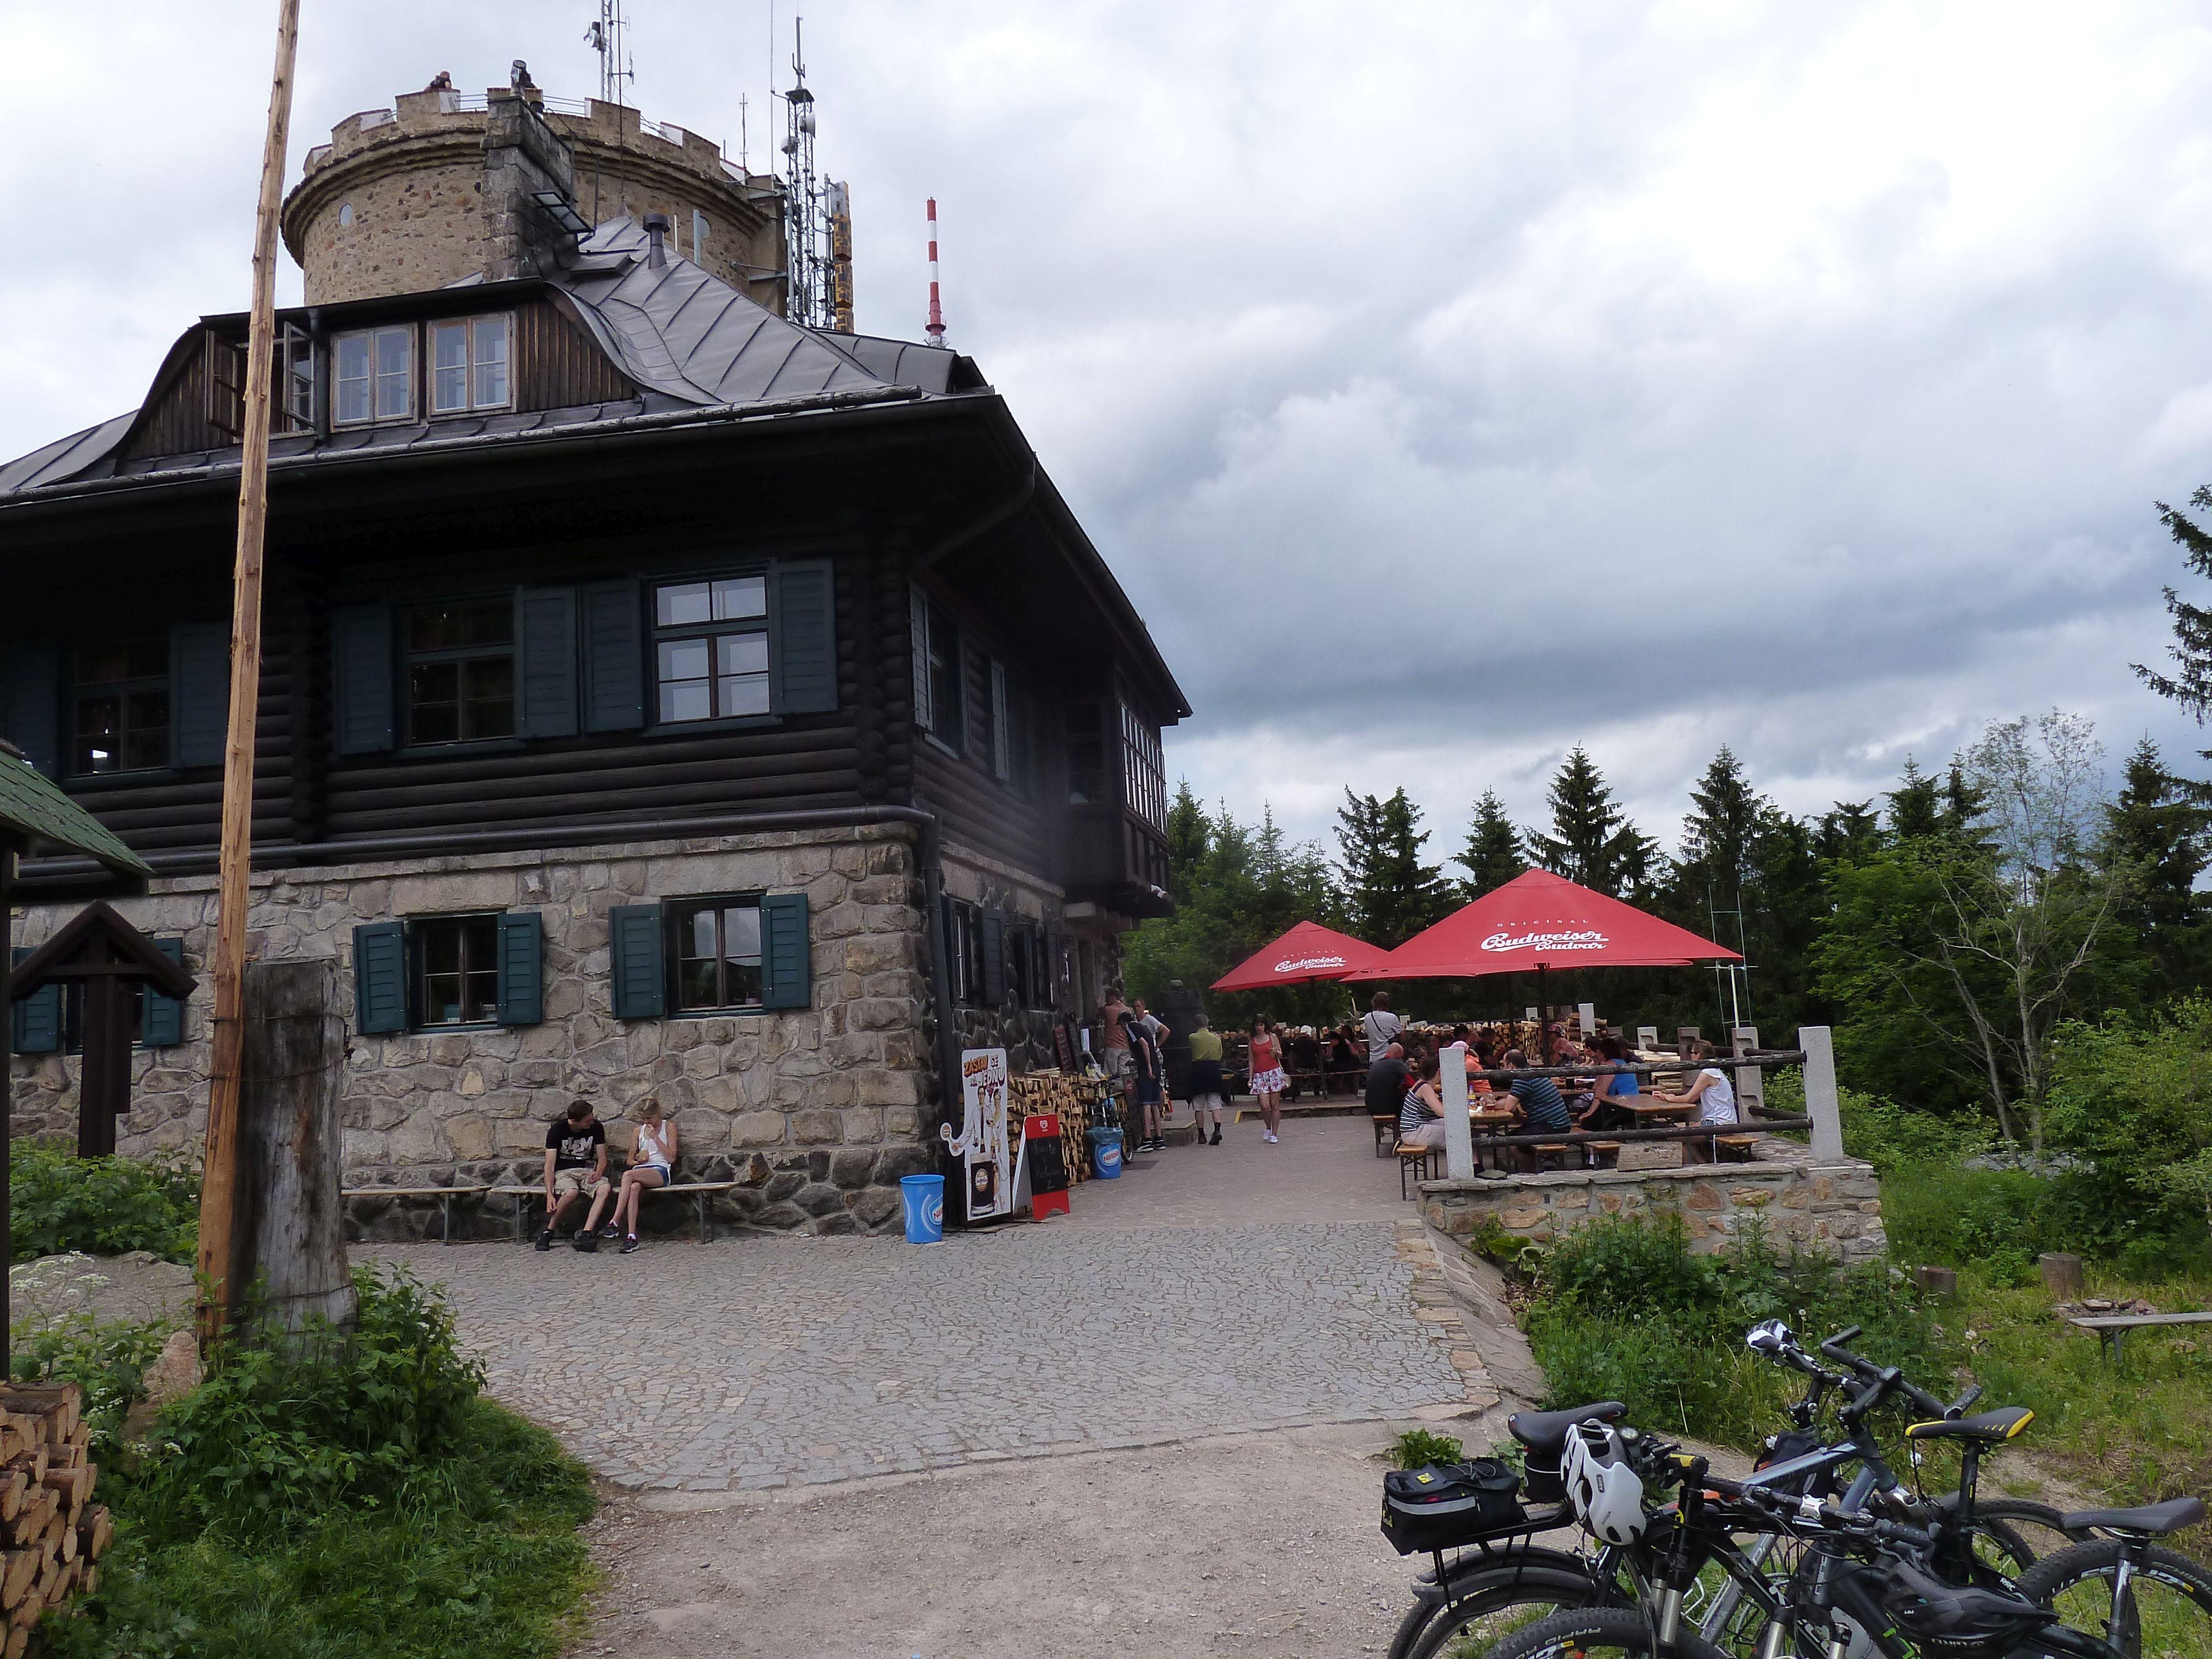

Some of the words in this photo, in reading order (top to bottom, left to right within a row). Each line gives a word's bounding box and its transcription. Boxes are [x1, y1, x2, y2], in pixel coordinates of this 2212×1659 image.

[1496, 919, 1588, 927] ORIGINAL
[1480, 930, 1610, 952] Budweiser
[1535, 940, 1607, 951] Budvar
[1274, 956, 1347, 972] Budweiser
[990, 1054, 999, 1068] SE
